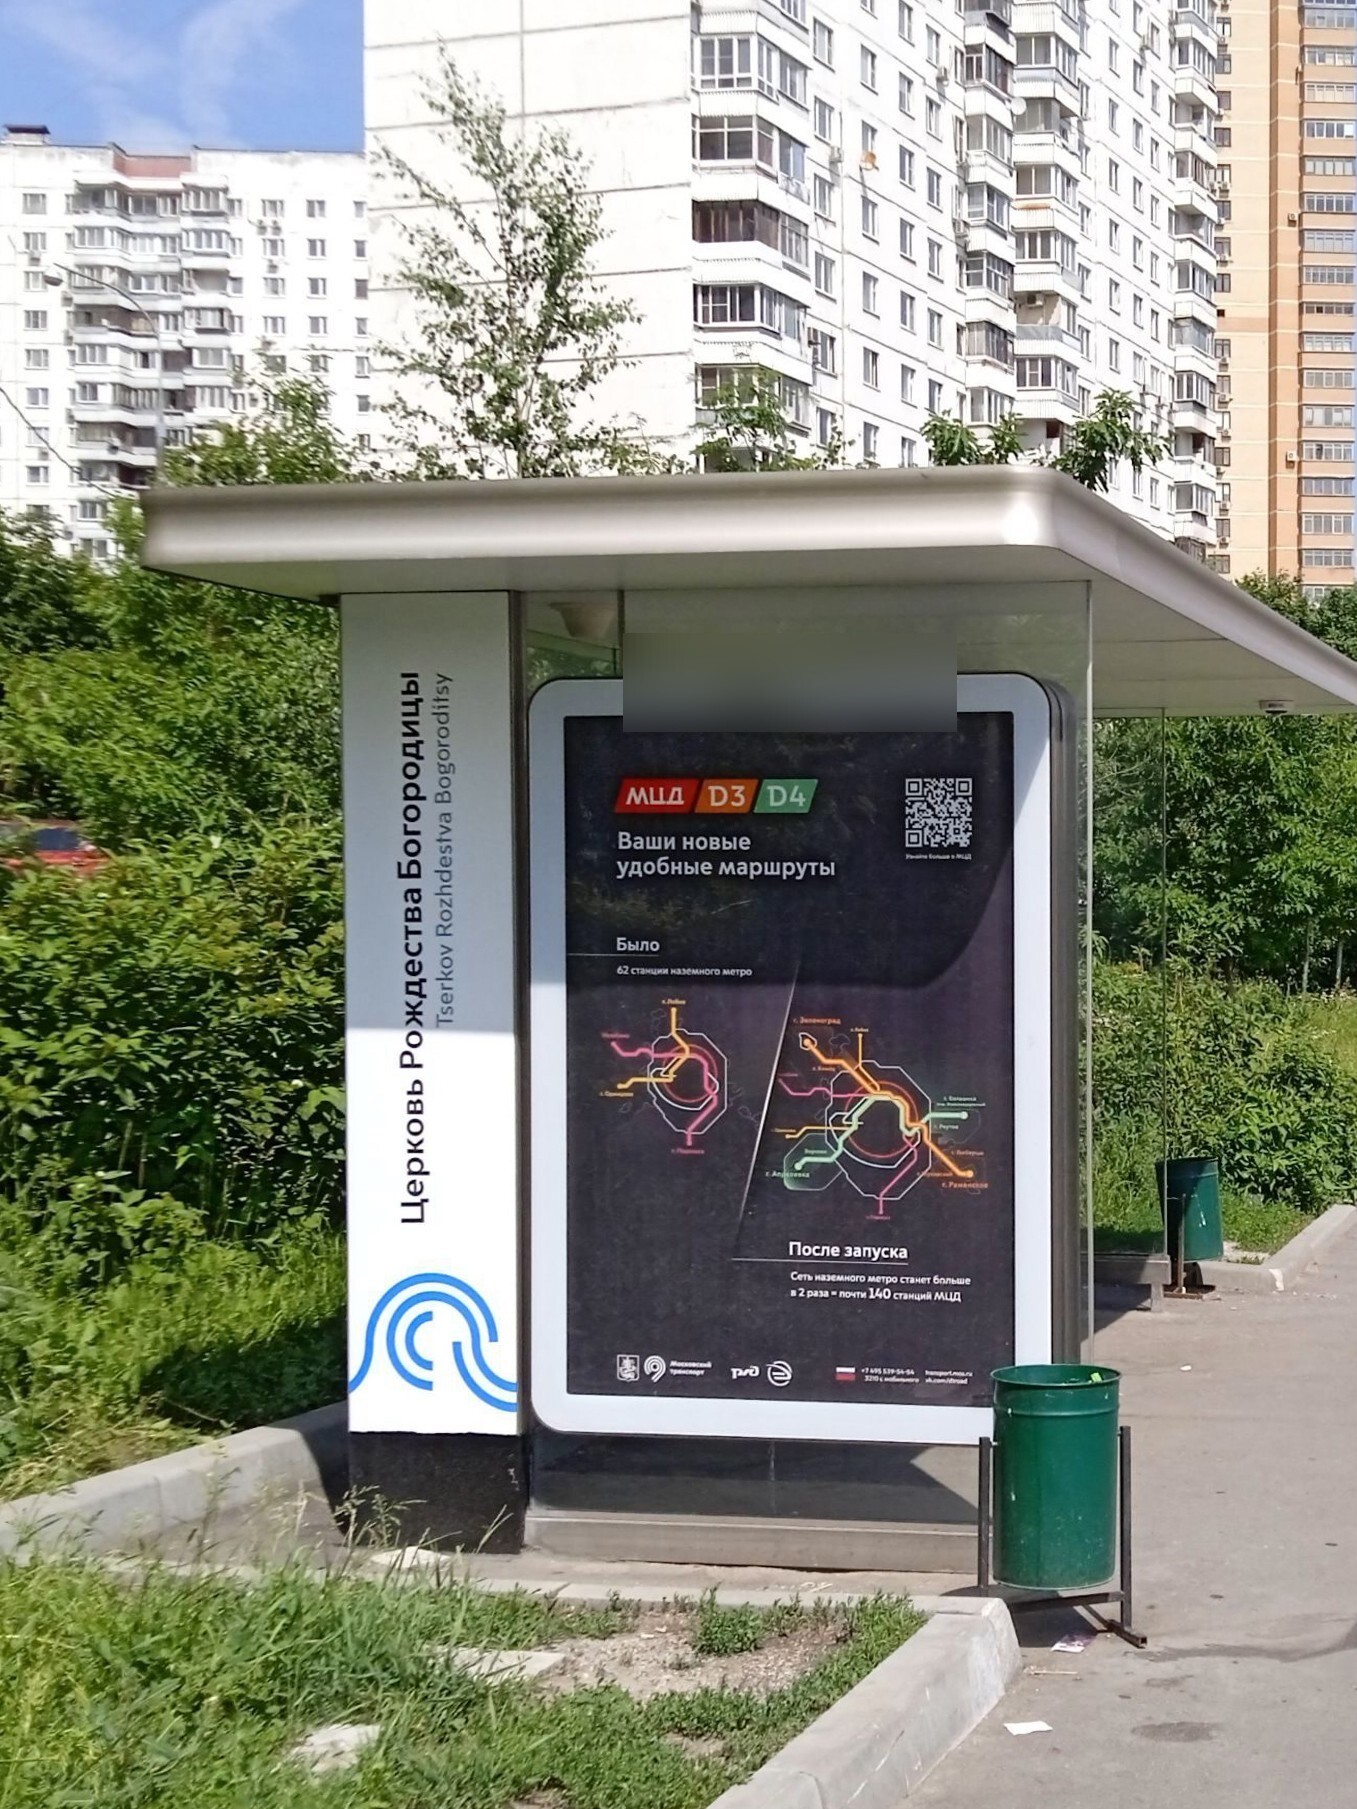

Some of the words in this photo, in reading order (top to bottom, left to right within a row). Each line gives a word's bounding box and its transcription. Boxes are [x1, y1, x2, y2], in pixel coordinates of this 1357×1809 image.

[431, 672, 456, 804] Bogoroditsy
[397, 672, 427, 880] Богородицы
[625, 786, 685, 806] МЦД
[708, 785, 746, 807] D3
[766, 785, 806, 807] D4
[617, 831, 676, 850] Ваши
[682, 836, 752, 850] новые
[434, 812, 454, 937] Rozhdestva
[616, 856, 713, 879] удобные
[718, 861, 836, 880] маршруты
[616, 937, 660, 952] Было
[399, 888, 427, 1069] Рождества
[616, 966, 629, 975] 62
[630, 967, 669, 976] станции
[670, 968, 721, 976] наземного
[722, 969, 753, 978] метро
[435, 944, 454, 1028] Tserkov
[400, 1079, 430, 1223] Церковь
[788, 1241, 840, 1257] После
[844, 1245, 909, 1262] запуска
[790, 1271, 813, 1282] Сеть
[814, 1274, 866, 1284] наземного
[867, 1276, 898, 1286] метро
[899, 1276, 931, 1285] станет
[932, 1275, 972, 1286] больше
[798, 1288, 806, 1297] 2
[806, 1290, 829, 1300] раза
[838, 1291, 867, 1299] почти
[868, 1287, 892, 1300] 140
[892, 1291, 932, 1301] станций
[933, 1292, 962, 1303] МЦД
